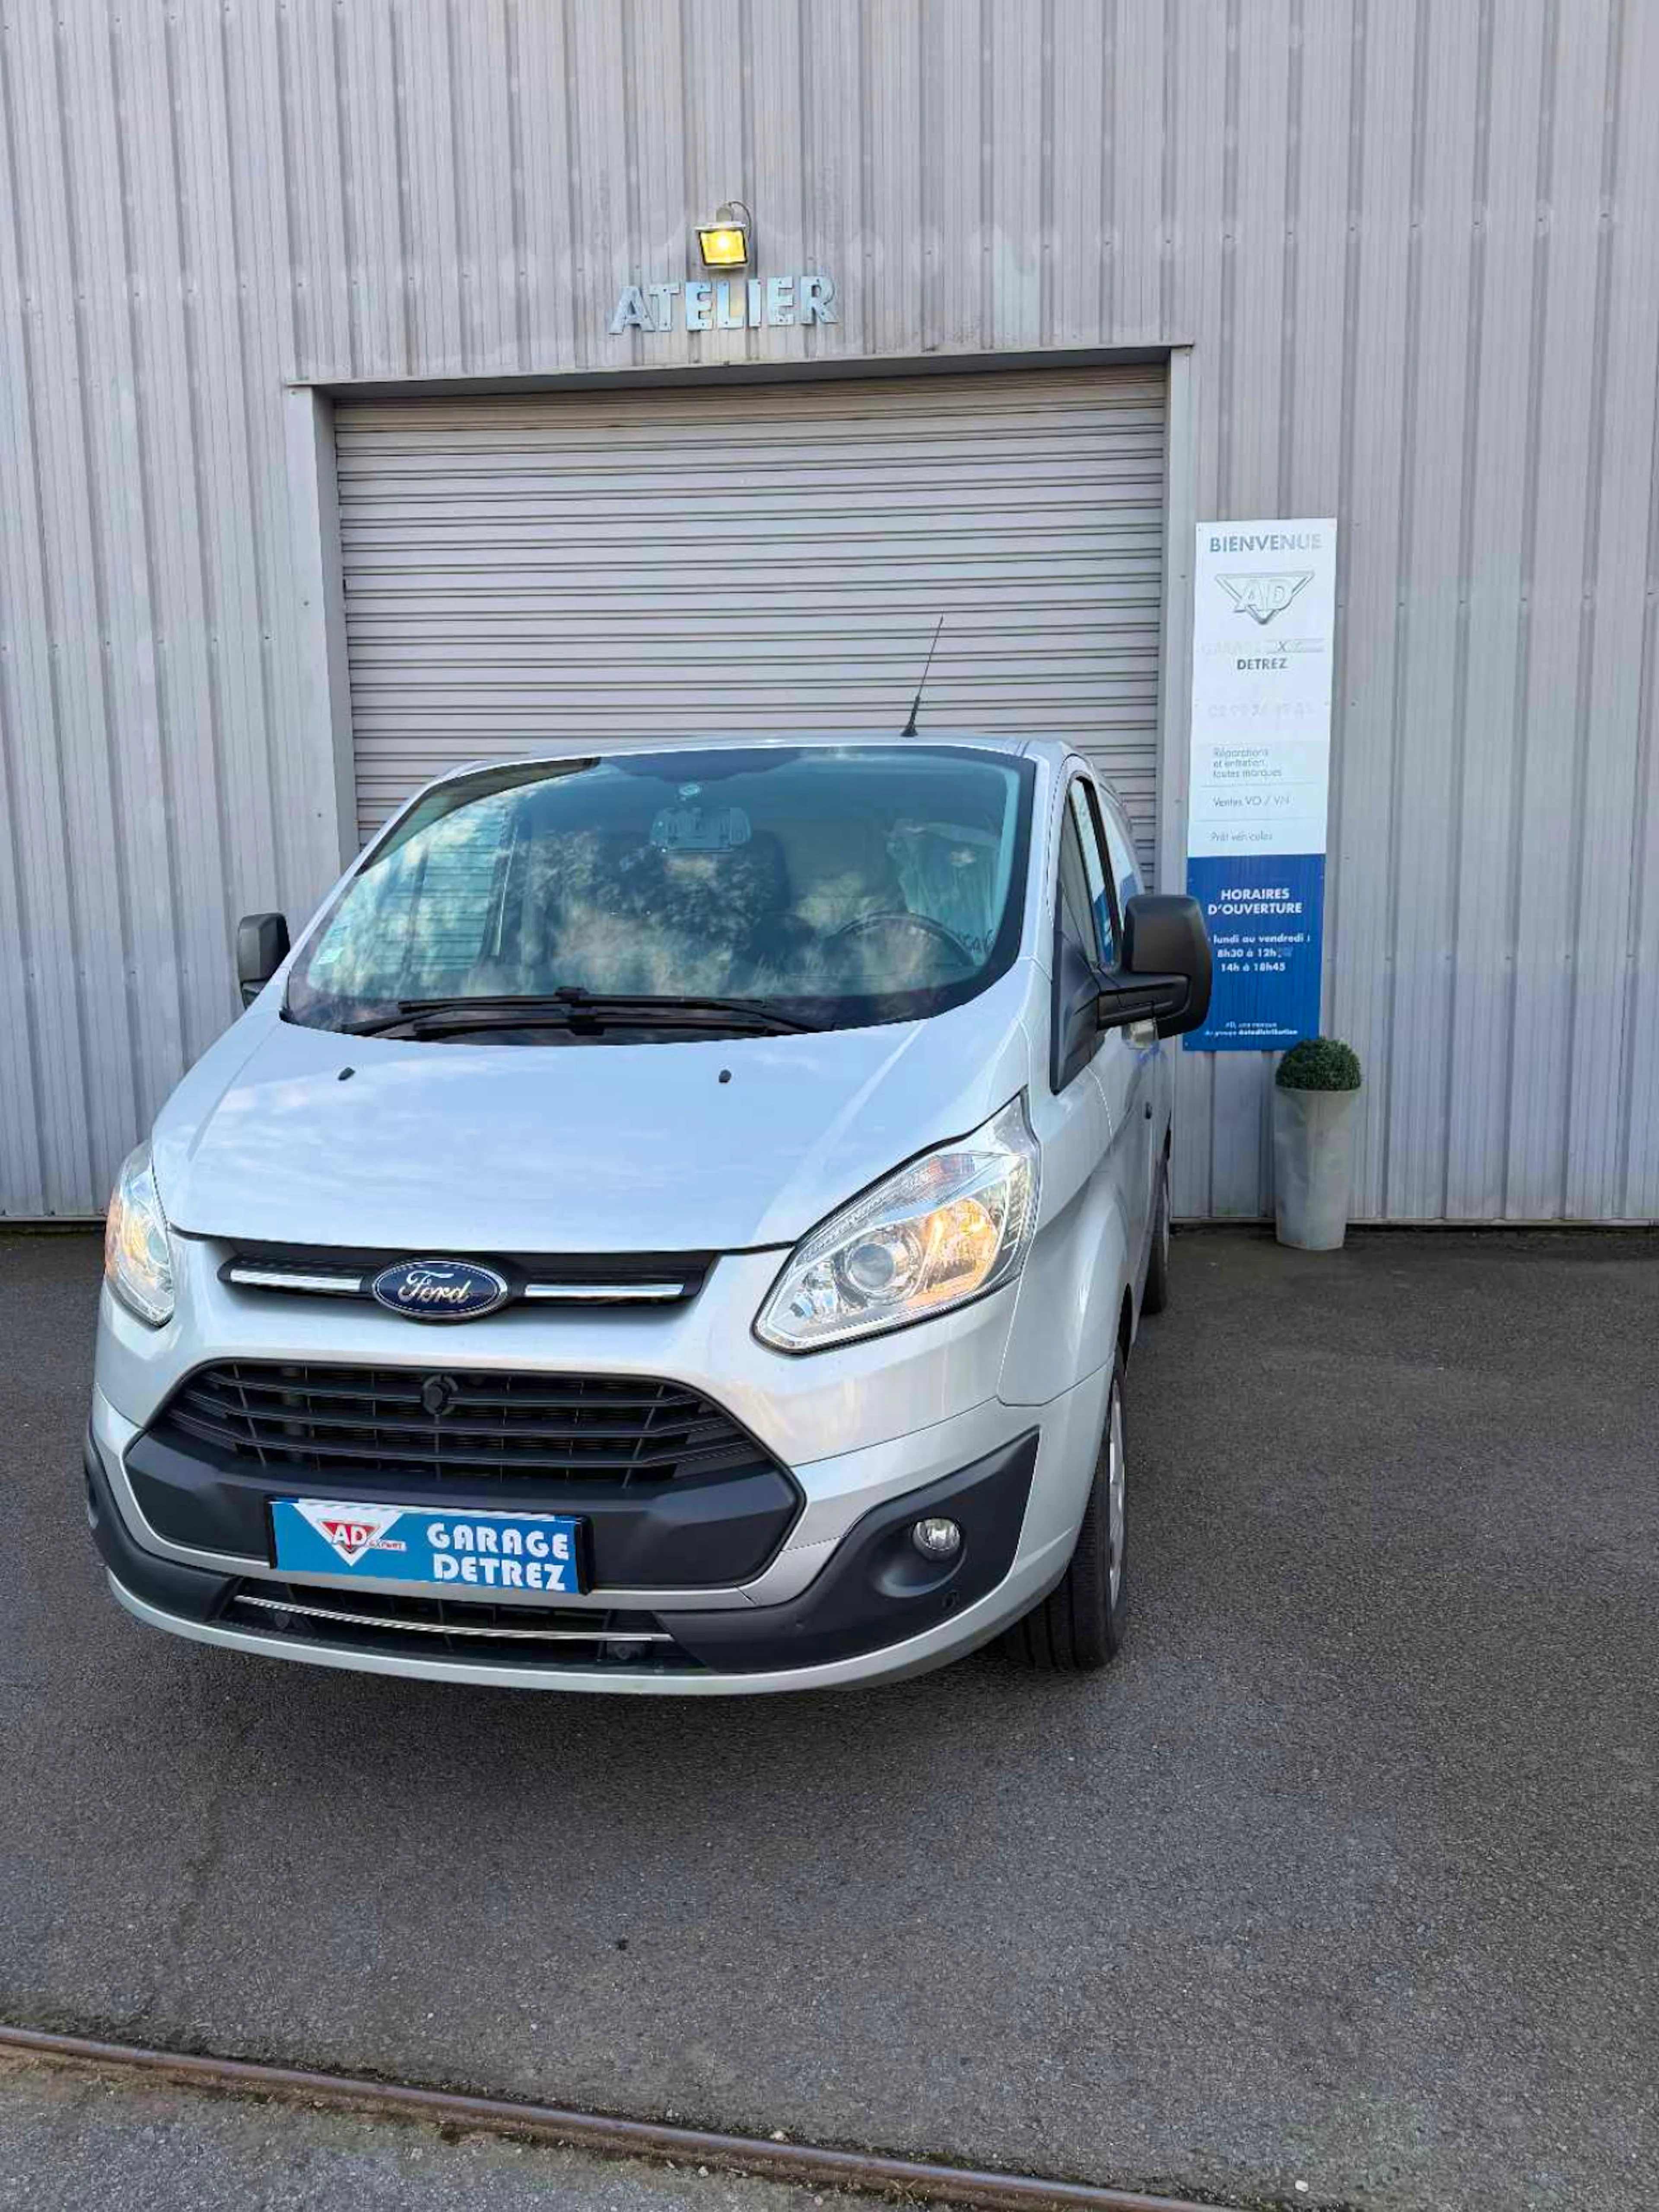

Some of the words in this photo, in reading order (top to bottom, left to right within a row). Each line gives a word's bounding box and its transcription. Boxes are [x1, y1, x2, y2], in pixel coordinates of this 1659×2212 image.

[609, 276, 840, 335] ATELIER
[1210, 534, 1321, 552] BIENVENUE
[1237, 658, 1288, 670] DETREZ
[1245, 796, 1262, 805] VO
[1220, 888, 1290, 901] HORAIRES
[1208, 902, 1302, 915] D'OUVERTURE
[1214, 934, 1239, 944] lundi
[1259, 933, 1304, 942] vendredi
[1217, 949, 1243, 958] 8h30
[1246, 948, 1253, 958] à
[1221, 963, 1240, 972] 14h
[1243, 963, 1250, 972] à
[1254, 962, 1286, 971] 18h45
[397, 1270, 471, 1303] Ford
[333, 1524, 368, 1547] AD
[426, 1522, 569, 1560] GARAGE
[433, 1553, 565, 1591] DETREZ
